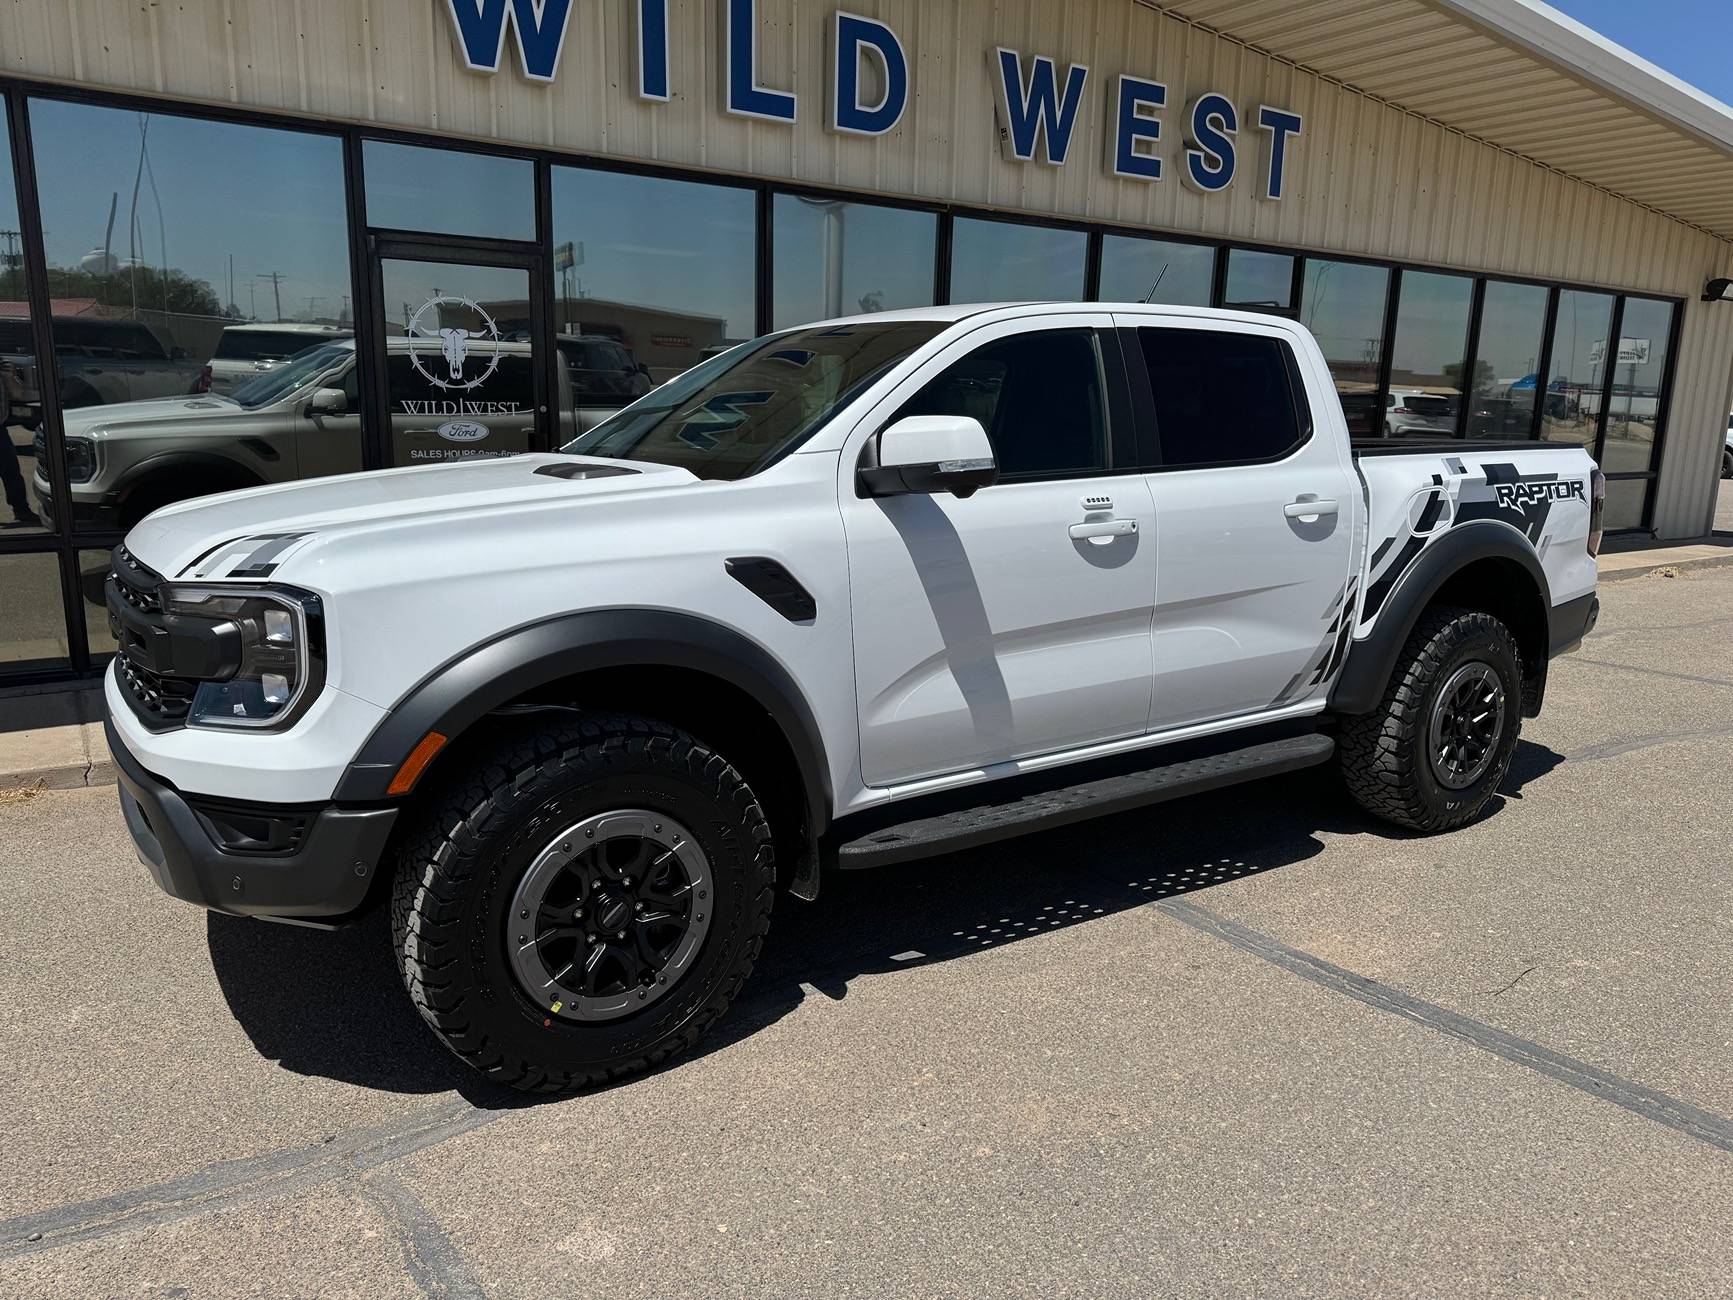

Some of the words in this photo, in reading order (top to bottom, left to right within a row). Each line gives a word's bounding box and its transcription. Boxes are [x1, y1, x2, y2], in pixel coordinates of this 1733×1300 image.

[446, 0, 908, 136] WILD
[996, 46, 1302, 200] WEST
[401, 400, 457, 415] WILD
[464, 401, 519, 416] WEST
[448, 424, 478, 437] Ford
[411, 450, 442, 458] SALES
[444, 450, 475, 458] HOURS
[1494, 479, 1588, 515] RAPTOR
